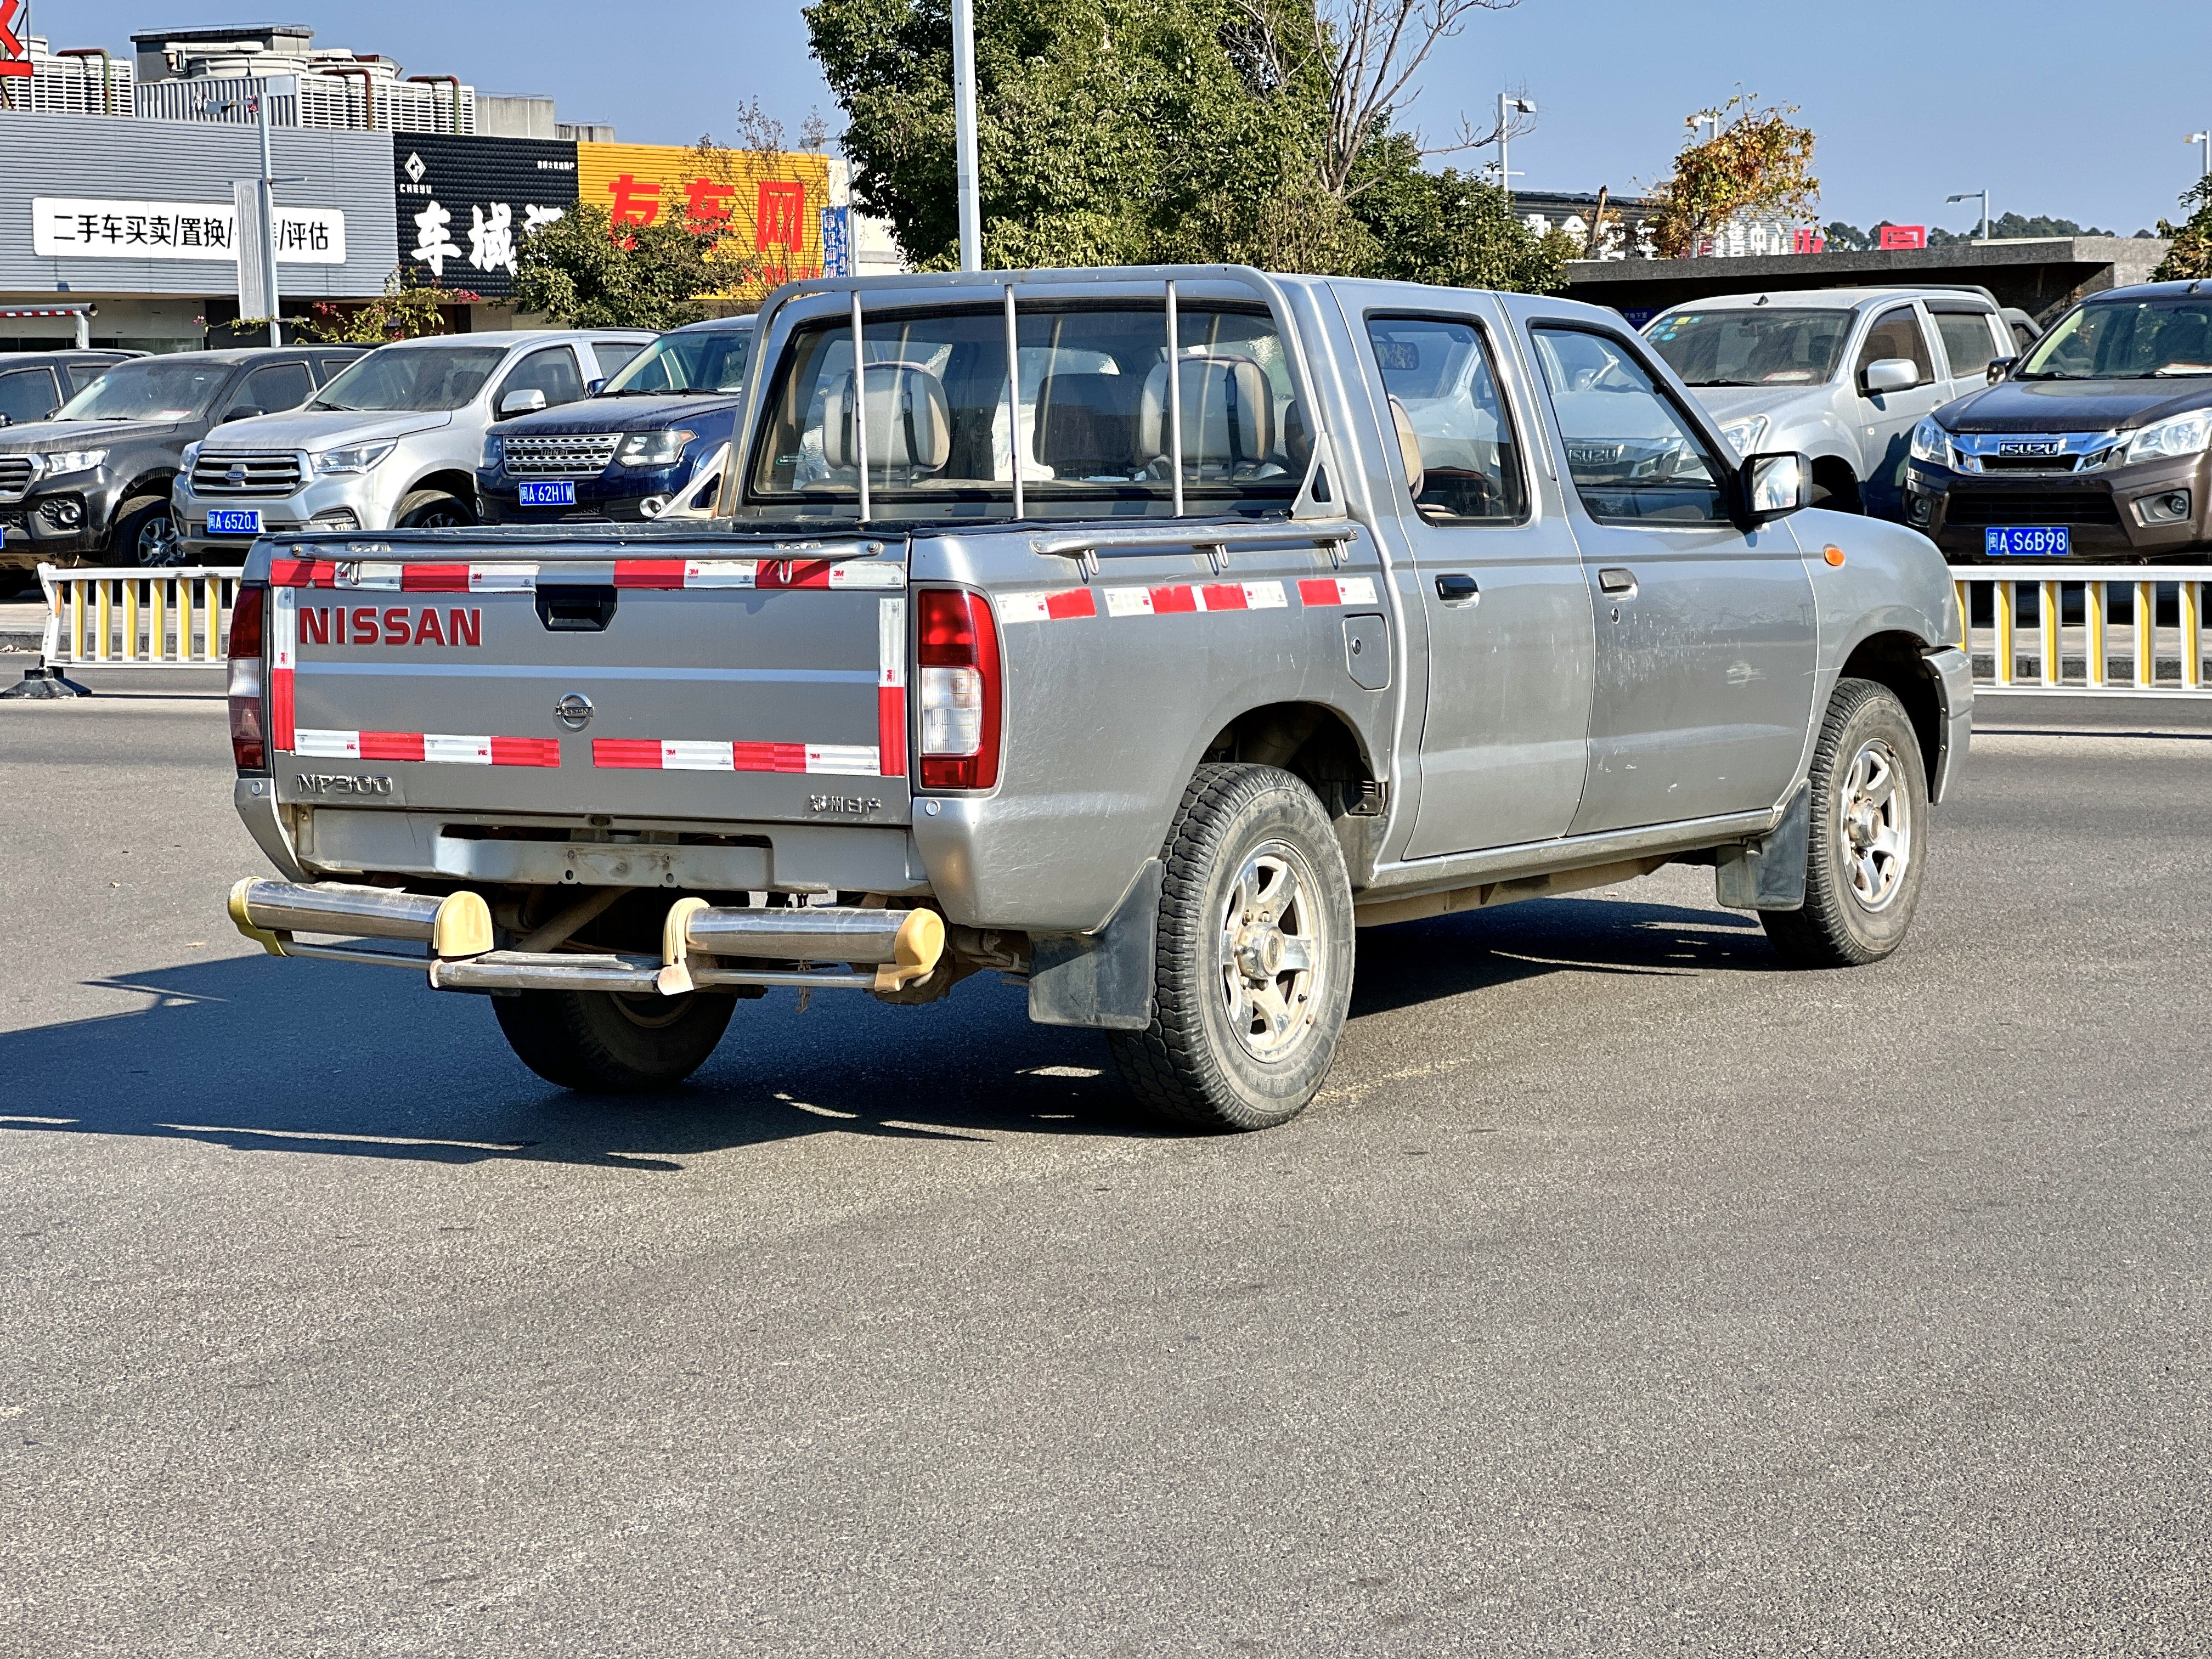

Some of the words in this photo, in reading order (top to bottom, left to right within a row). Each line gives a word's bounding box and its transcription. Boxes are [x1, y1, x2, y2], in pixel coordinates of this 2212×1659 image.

[400, 184, 432, 194] CHEYU
[54, 213, 329, 251] 二手车买卖/置换//评估
[2001, 443, 2057, 455] ISUZU
[299, 607, 482, 646] NISSAN
[887, 669, 893, 682] 3M
[296, 774, 393, 795] NP300
